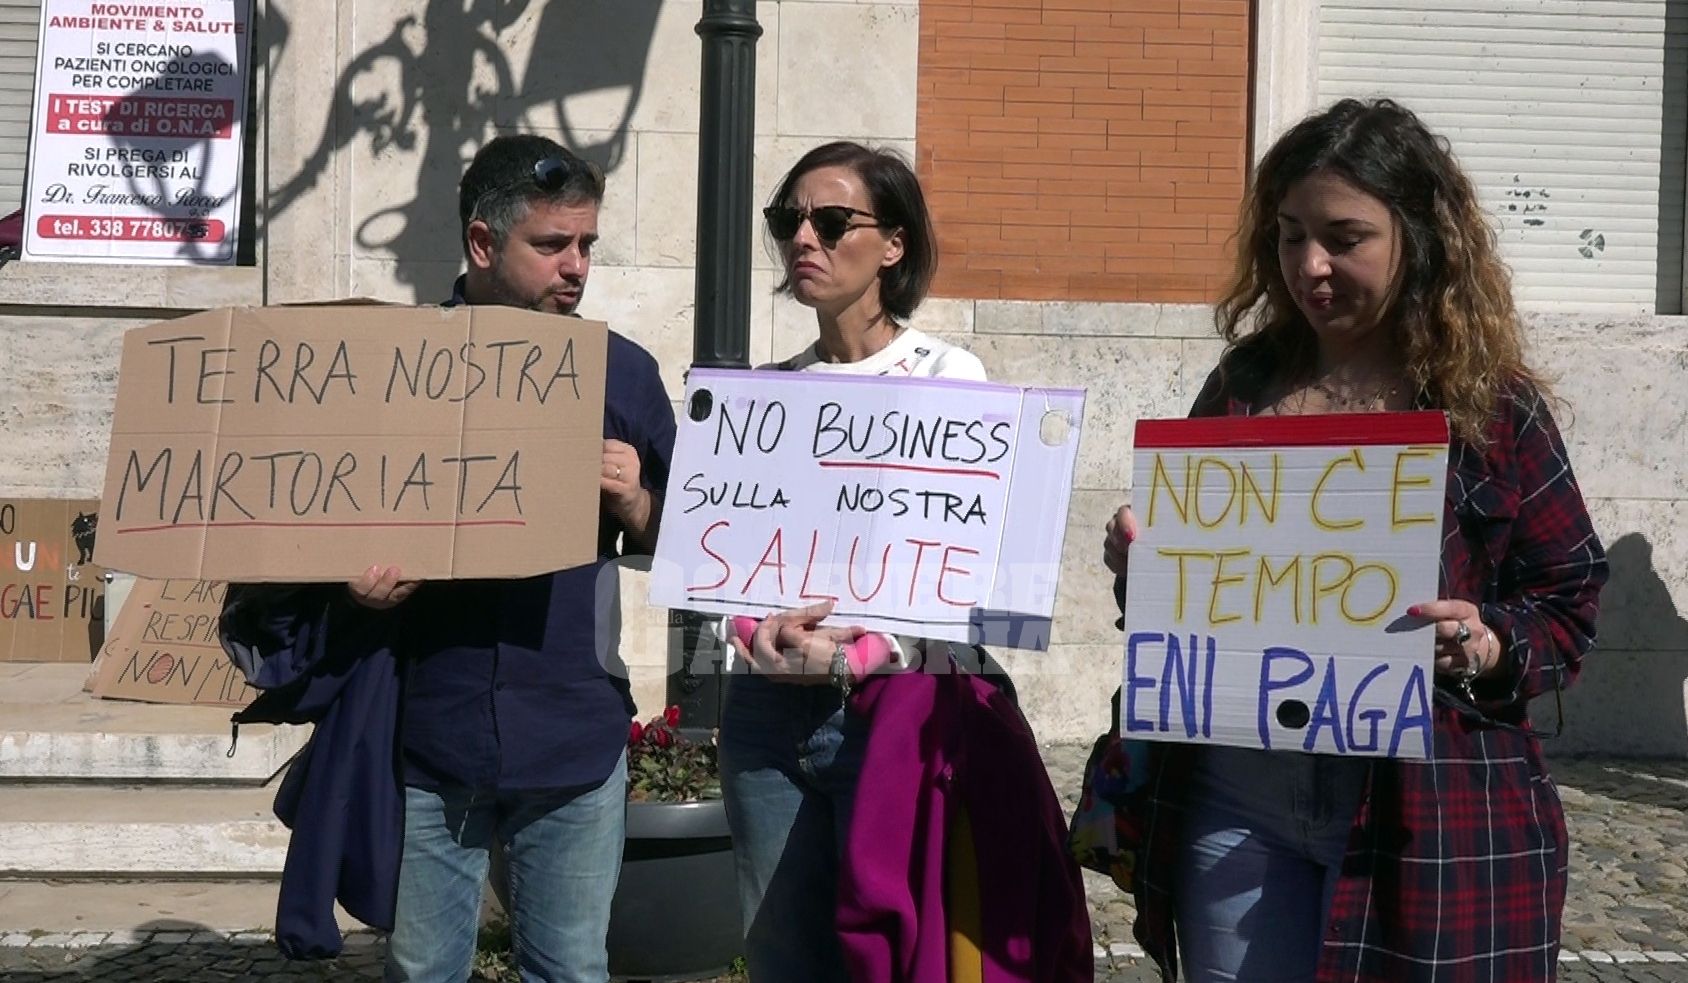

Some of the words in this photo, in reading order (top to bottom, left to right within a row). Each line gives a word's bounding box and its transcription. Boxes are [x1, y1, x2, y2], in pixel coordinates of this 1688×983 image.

[91, 4, 204, 19] MOVIMENTO
[49, 16, 146, 31] AMBIENTE
[152, 20, 165, 32] &
[172, 20, 245, 34] SALUTE
[96, 42, 110, 55] SI
[115, 43, 193, 58] CERCANO
[54, 57, 126, 72] PAZIENTI
[131, 59, 233, 76] ONCOLOGICI
[72, 74, 103, 88] PER
[107, 76, 214, 92] COMPLETARE
[54, 98, 60, 114] I
[66, 99, 114, 115] TEST
[119, 101, 139, 116] DI
[144, 102, 226, 118] RICERCA
[57, 119, 70, 131] a
[77, 119, 124, 132] cura
[131, 119, 150, 133] di
[156, 119, 221, 135] O.N.A.
[84, 148, 101, 160] SI
[106, 148, 166, 163] PREGA
[172, 150, 188, 163] DI
[68, 163, 175, 179] RIVOLGERSI
[179, 165, 201, 180] AL
[41, 183, 75, 204] Dr.
[82, 184, 162, 207] Francesco
[168, 187, 224, 208] Rocca
[53, 219, 83, 235] tel.
[90, 220, 124, 237] 338
[147, 336, 358, 404] TERRA
[385, 337, 581, 405] NOSTRA
[713, 400, 786, 457] NO
[812, 402, 1010, 464] BUSINESS
[116, 447, 524, 525] MARTORIATA
[1146, 452, 1280, 529] NON
[683, 473, 791, 514] SULLA
[836, 483, 987, 525] NOSTRA
[686, 520, 980, 608] SALUTE
[1157, 549, 1397, 626] TEMPO
[118, 650, 201, 687] NON
[1126, 631, 1216, 739] ENI
[1256, 646, 1435, 760] PAGA
